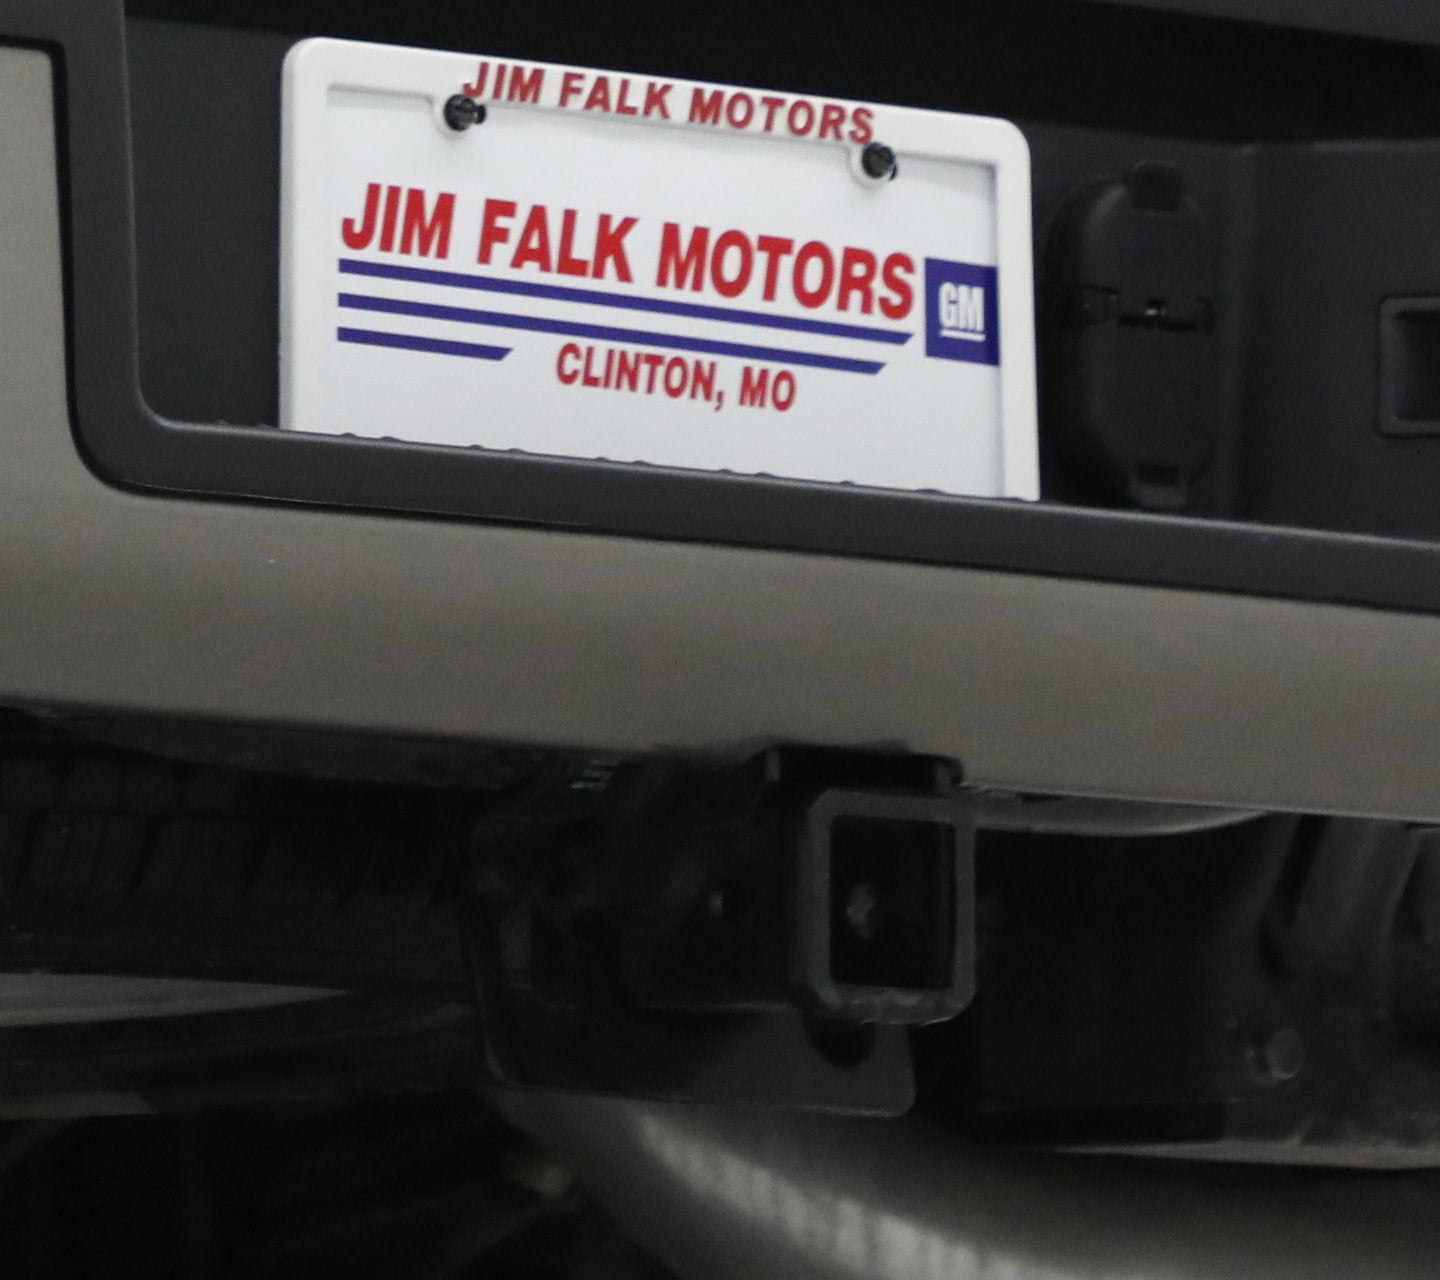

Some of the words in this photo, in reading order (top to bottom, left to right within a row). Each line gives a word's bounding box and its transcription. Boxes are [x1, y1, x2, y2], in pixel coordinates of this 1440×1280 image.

[462, 61, 545, 104] JIM
[559, 72, 672, 121] FALK
[689, 89, 876, 146] MOTORS
[342, 183, 456, 260] JIM
[476, 200, 640, 284] FALK
[656, 221, 916, 322] MOTORS
[938, 280, 985, 332] GM
[557, 342, 726, 412] CLINTON,
[738, 366, 798, 413] MO
